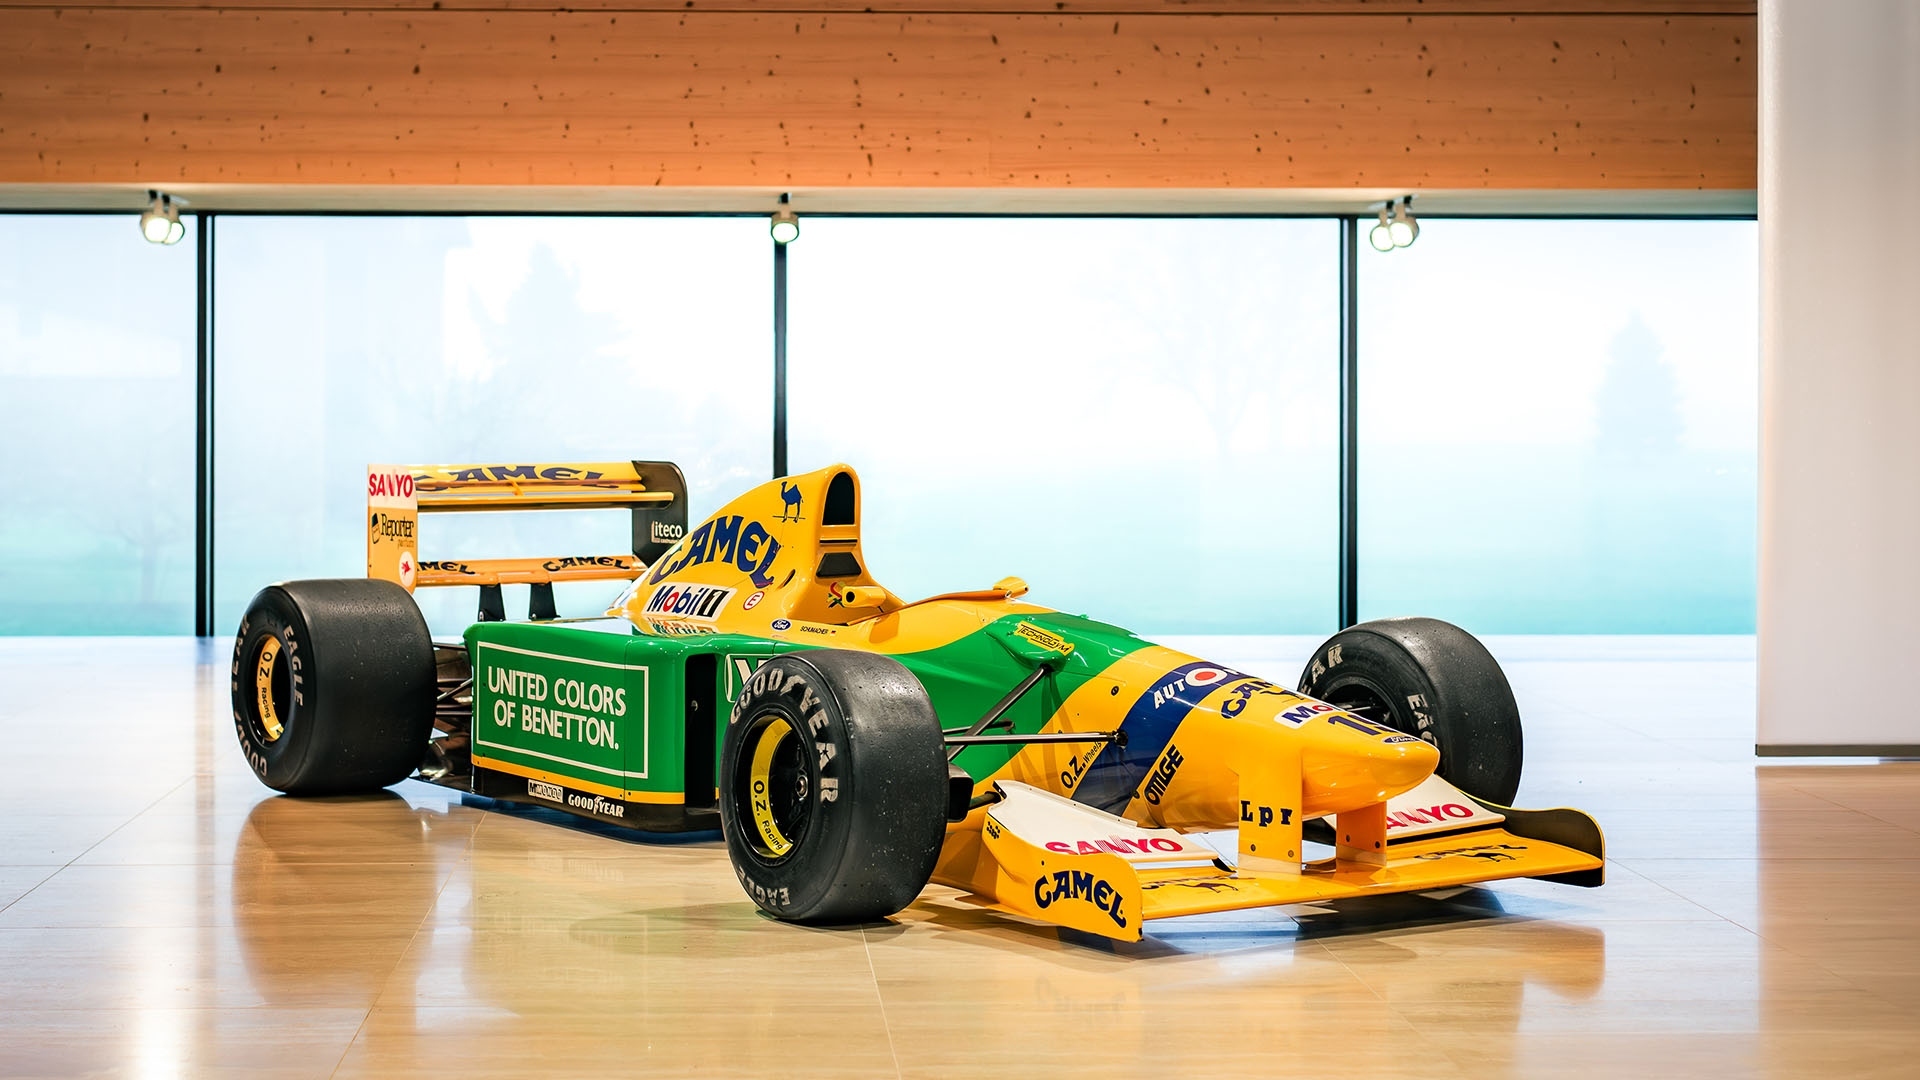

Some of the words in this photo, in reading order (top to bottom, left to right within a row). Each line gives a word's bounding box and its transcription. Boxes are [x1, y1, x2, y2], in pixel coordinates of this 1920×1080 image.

[368, 473, 413, 498] SANYO
[380, 513, 415, 541] Reporter
[543, 556, 631, 571] CAMEL
[649, 515, 781, 589] CAMEL
[418, 561, 475, 575] MEL
[646, 585, 705, 613] Mobil
[259, 651, 273, 683] O.Z.
[283, 624, 304, 707] EAGLE
[261, 687, 271, 718] Racing
[488, 666, 547, 702] UNITED
[554, 678, 627, 717] COLORS
[494, 700, 516, 728] OF
[521, 705, 620, 751] BENETTON.
[730, 667, 839, 804] GOODYEAR
[568, 795, 625, 818] GOODYEAR
[753, 780, 770, 817] O.Z.
[1386, 803, 1474, 830] ANYO
[761, 820, 784, 850] Racing
[1045, 837, 1184, 857] SANYO
[1034, 869, 1128, 929] CAMEL
